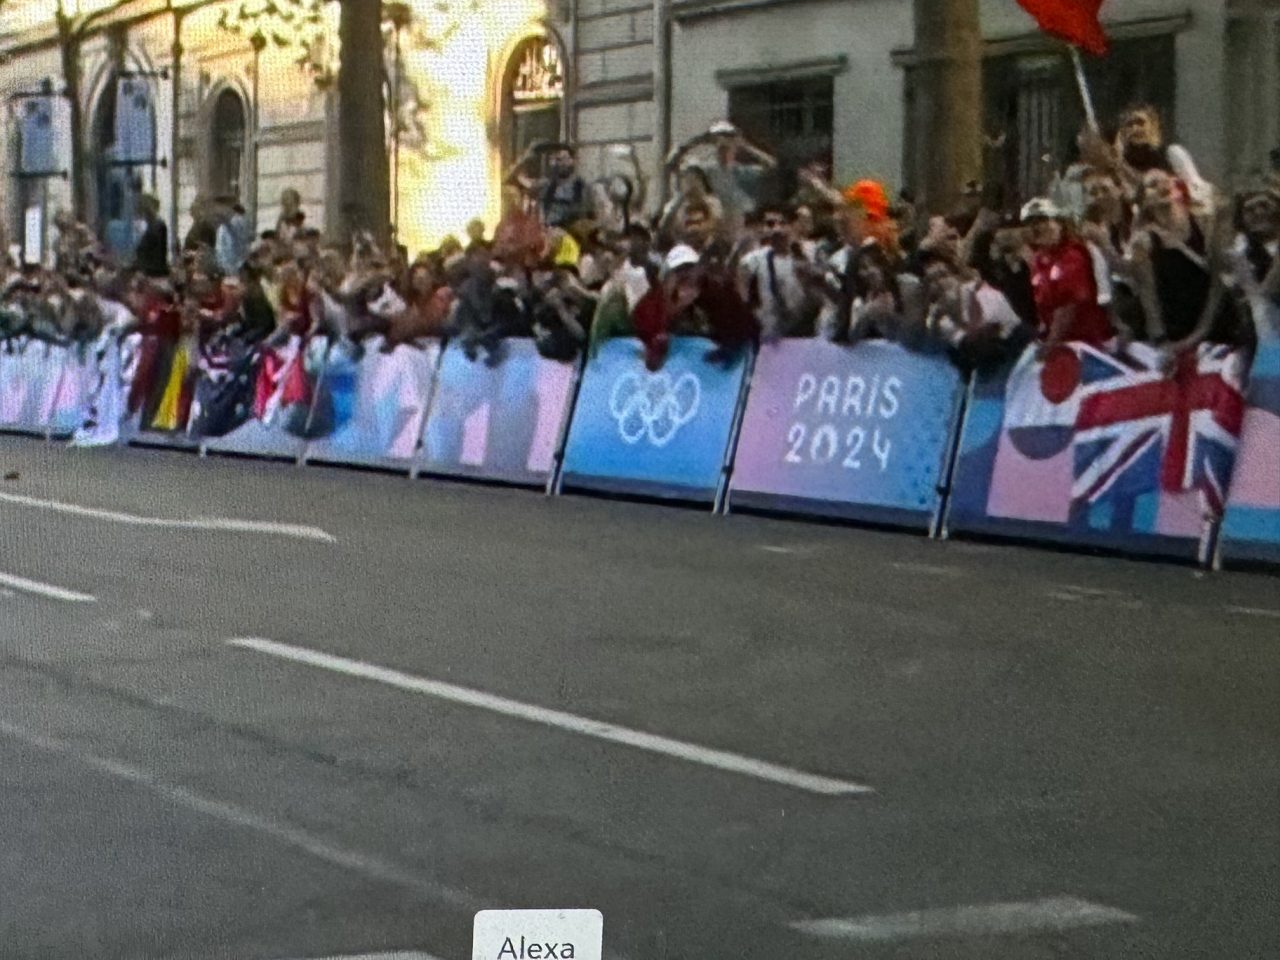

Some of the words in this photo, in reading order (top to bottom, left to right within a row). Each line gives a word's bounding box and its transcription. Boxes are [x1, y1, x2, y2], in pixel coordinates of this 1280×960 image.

[794, 373, 902, 419] PARIS
[785, 423, 891, 471] 2024
[497, 935, 574, 959] Alexa
